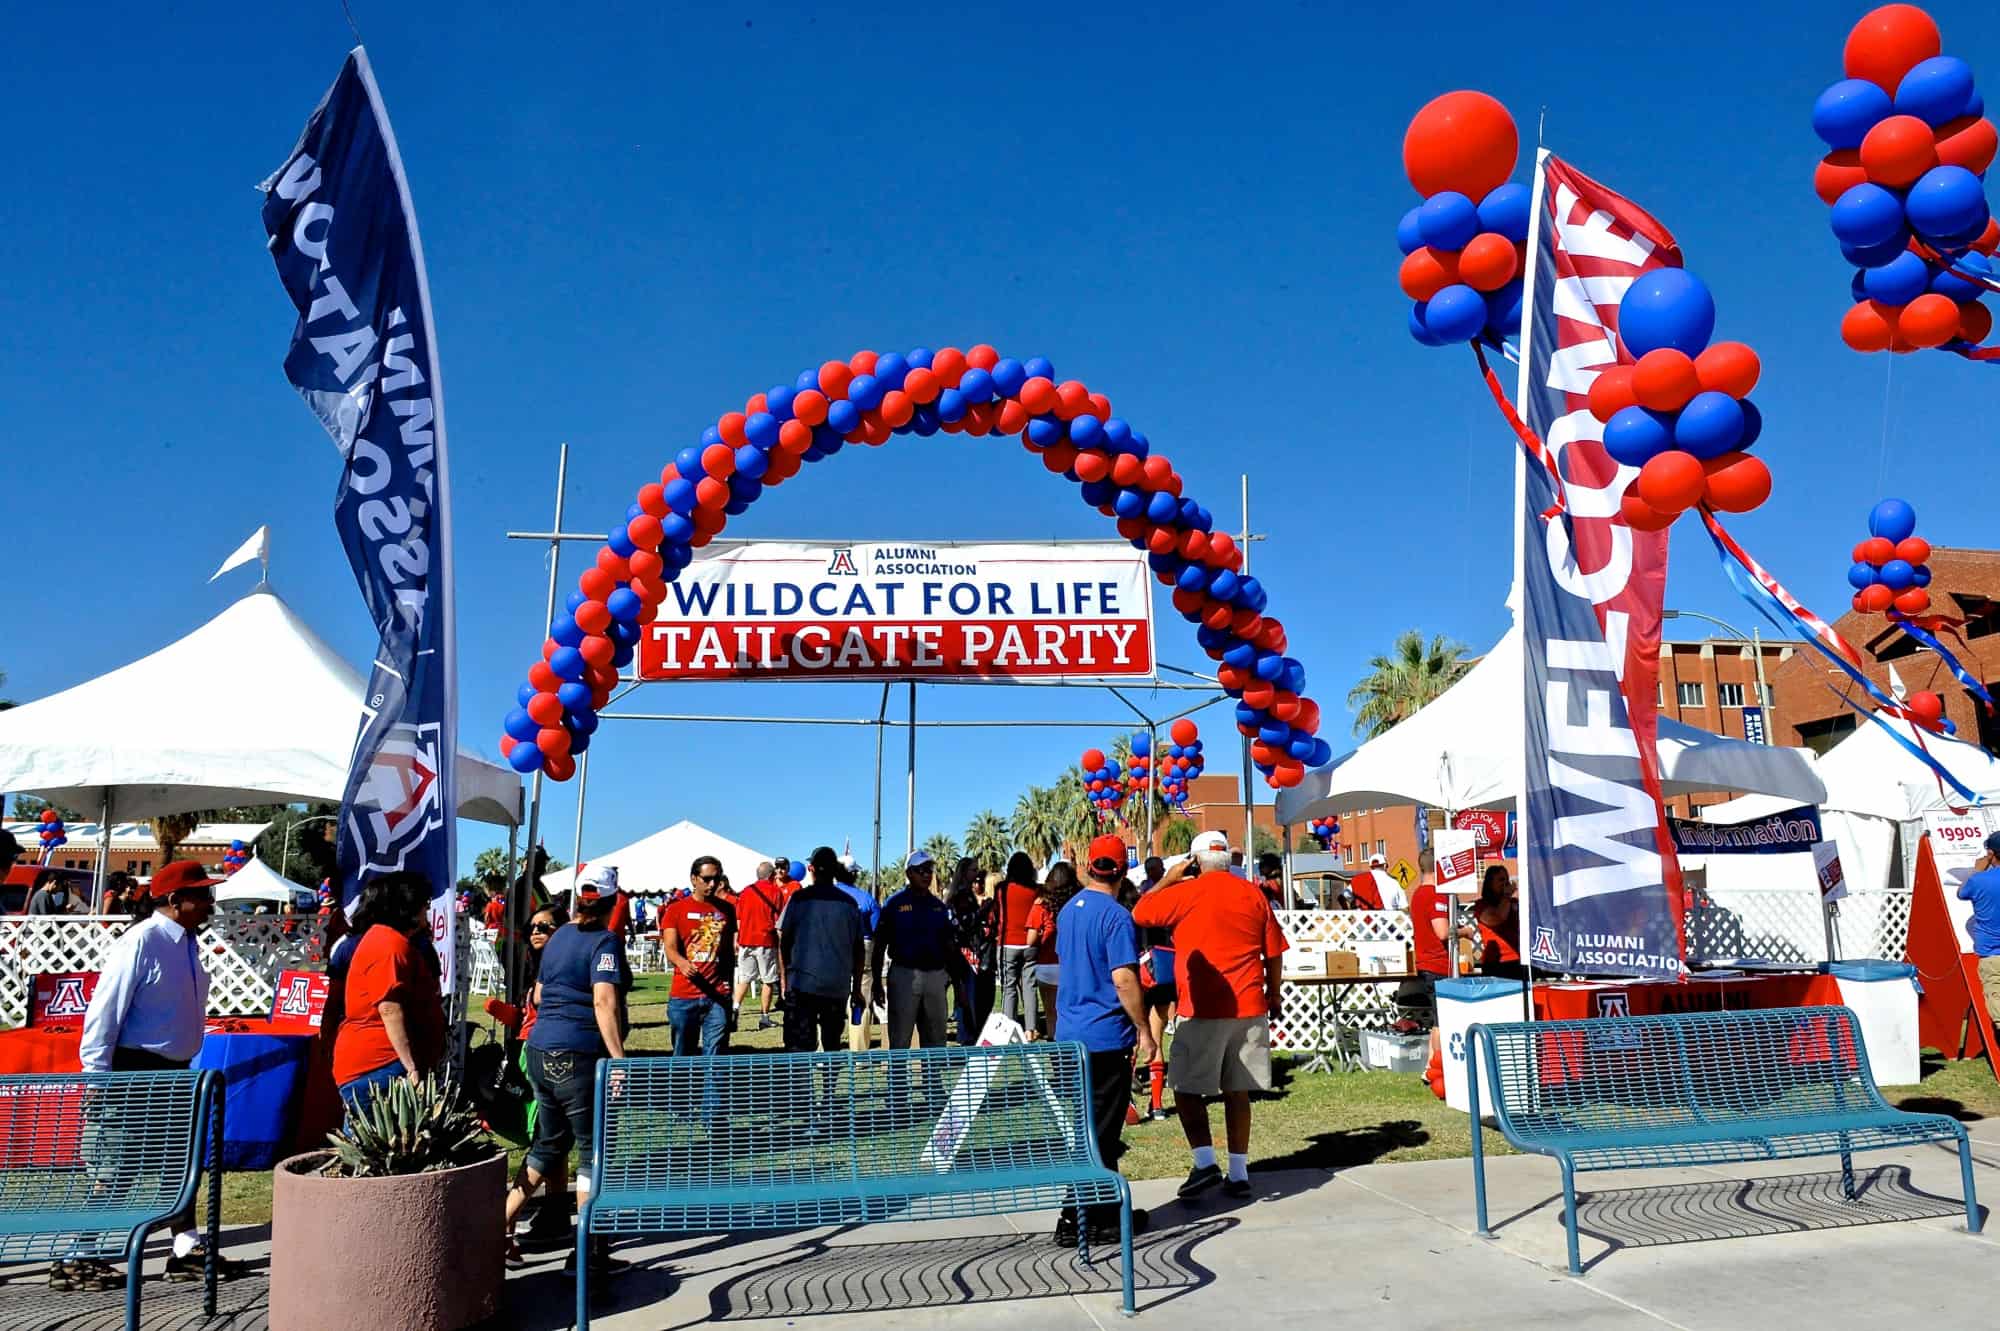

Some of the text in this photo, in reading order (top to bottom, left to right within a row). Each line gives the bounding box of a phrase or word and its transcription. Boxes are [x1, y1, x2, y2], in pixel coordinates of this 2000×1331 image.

[874, 548, 936, 560] ALUMNI
[1546, 181, 1663, 907] WELCOME
[875, 563, 977, 576] ASSOCIATION
[671, 582, 1120, 617] WILDCAT FOR LIFE
[653, 624, 1138, 670] TAILGATE PARTY
[1675, 817, 1817, 846] Information
[1937, 826, 1982, 841] 1990s
[1576, 934, 1645, 950] ALUMNI
